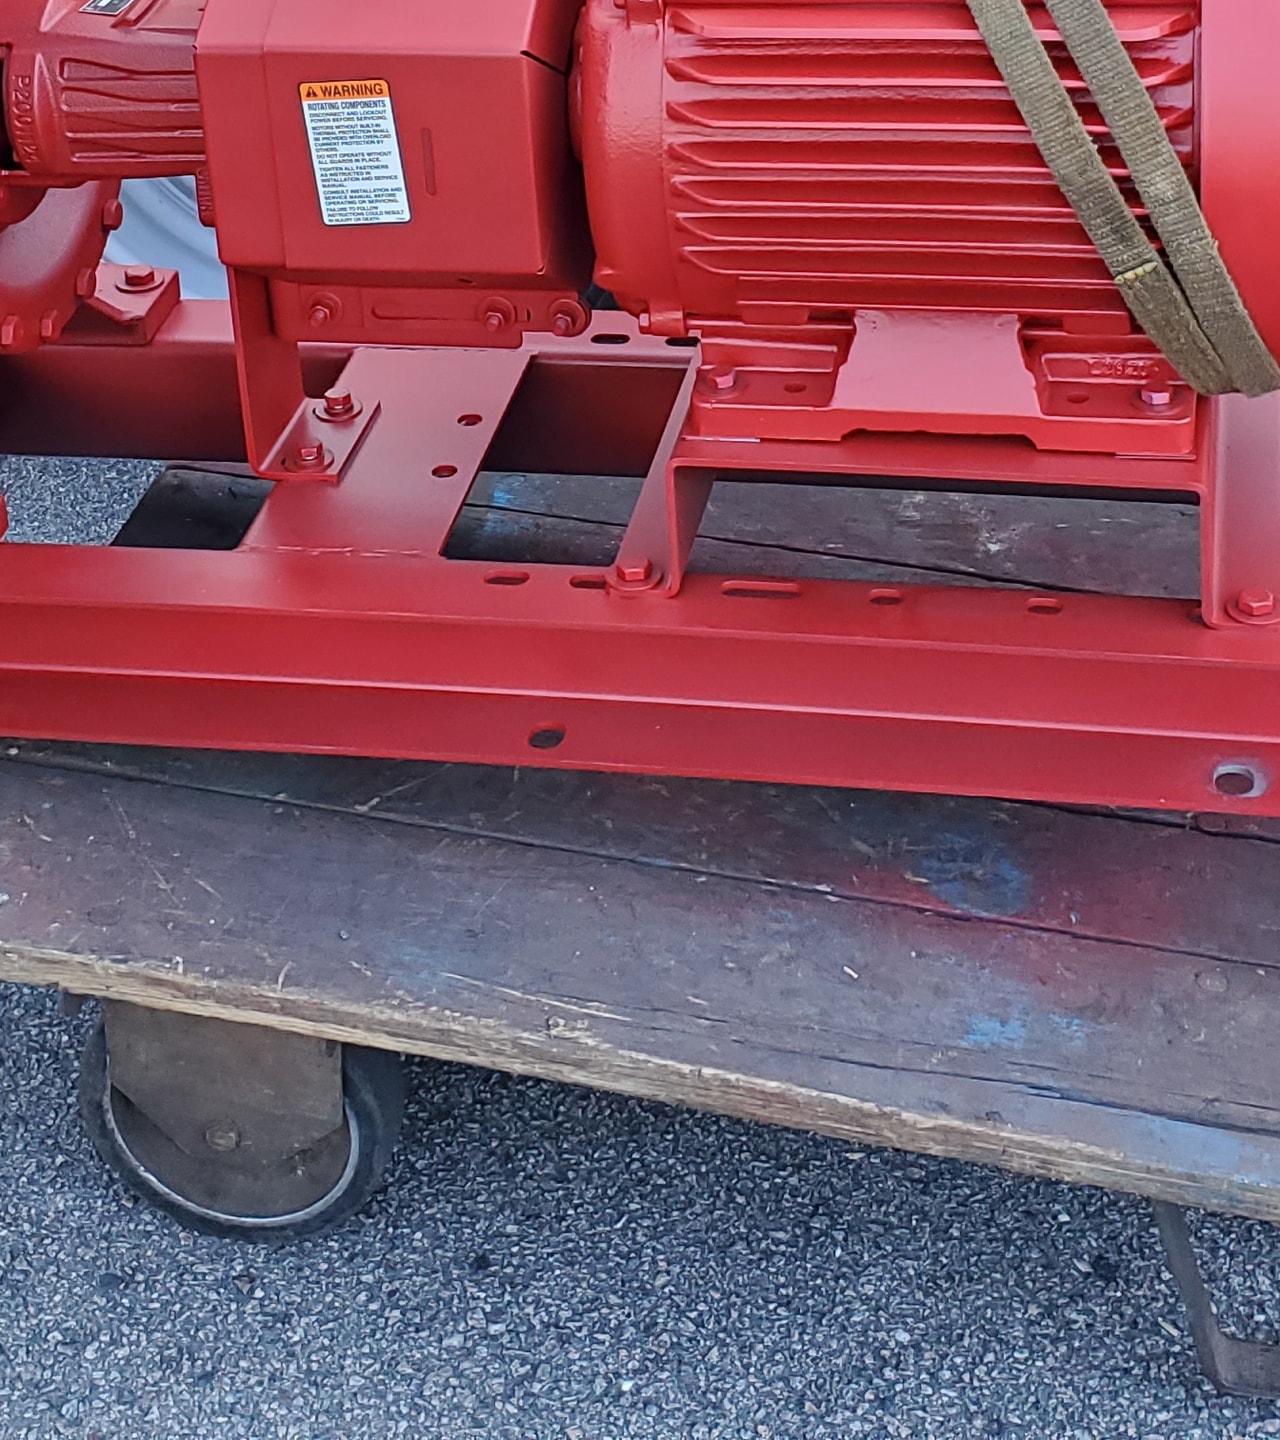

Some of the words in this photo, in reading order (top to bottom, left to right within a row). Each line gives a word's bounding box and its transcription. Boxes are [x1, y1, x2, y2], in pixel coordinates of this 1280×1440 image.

[320, 84, 384, 97] WARNING
[308, 102, 340, 111] ROTATING
[341, 100, 386, 109] COMPONENTS
